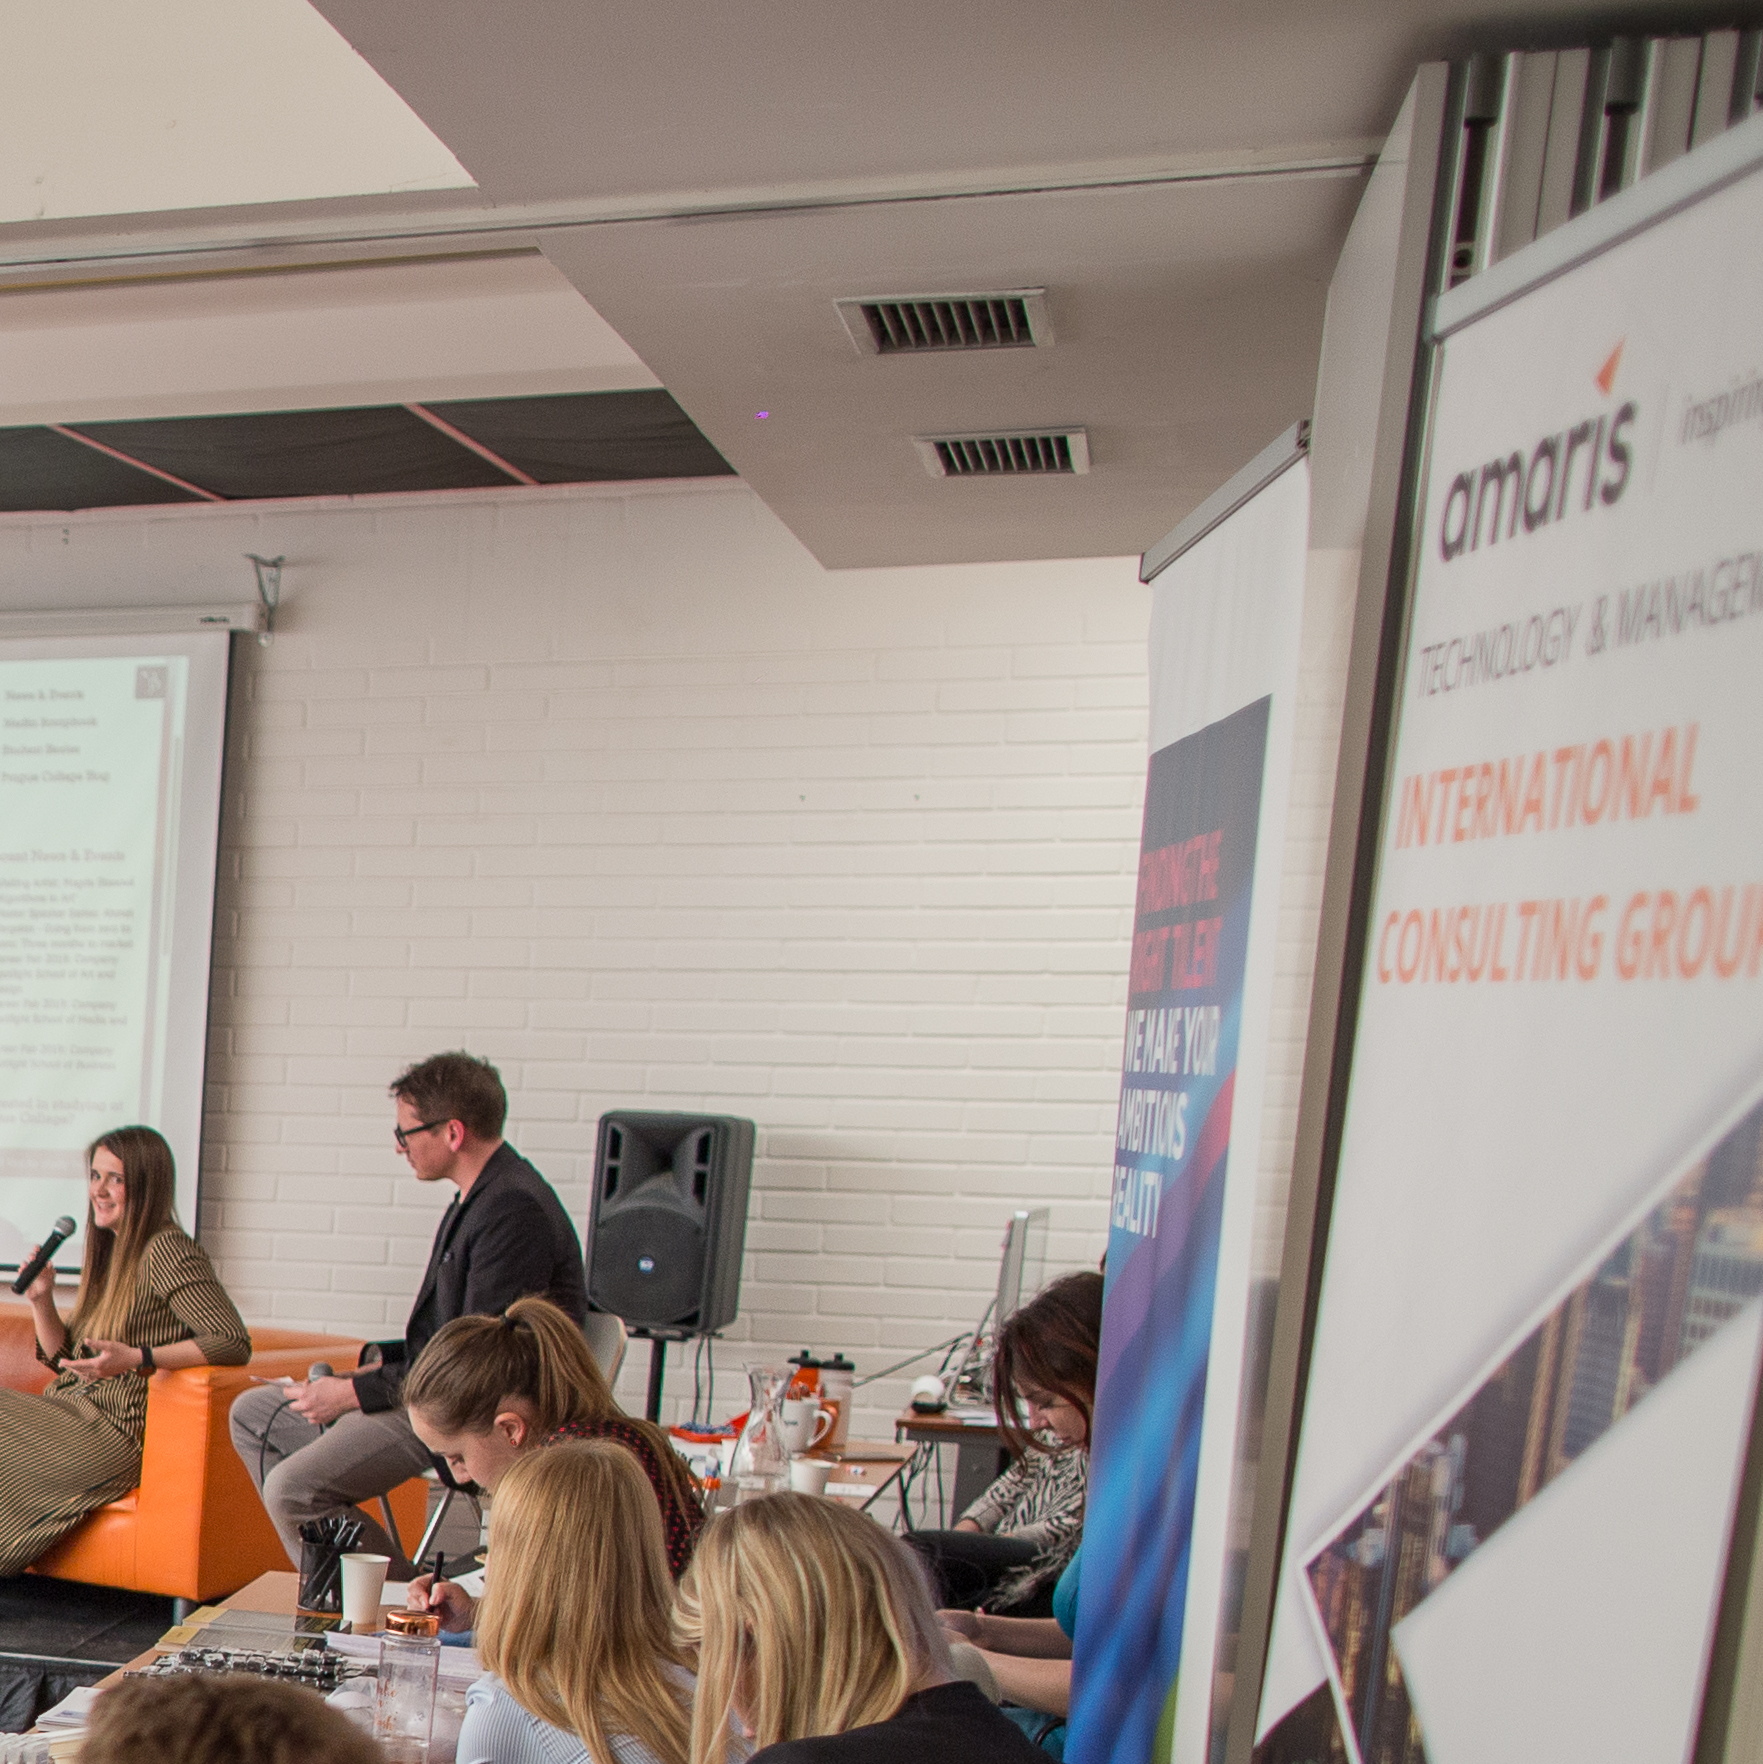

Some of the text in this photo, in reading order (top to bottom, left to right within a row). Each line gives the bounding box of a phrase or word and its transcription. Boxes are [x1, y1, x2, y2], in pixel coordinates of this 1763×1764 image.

[1439, 401, 1638, 564] amaris
[1418, 604, 1583, 699] TECHNOLOGY
[1587, 595, 1609, 656] &
[1395, 721, 1701, 850] INTERNATIONAL
[1377, 893, 1610, 984] CONSULTING
[1142, 1007, 1182, 1075] MAKE
[1117, 1088, 1189, 1161] AMBITIONS
